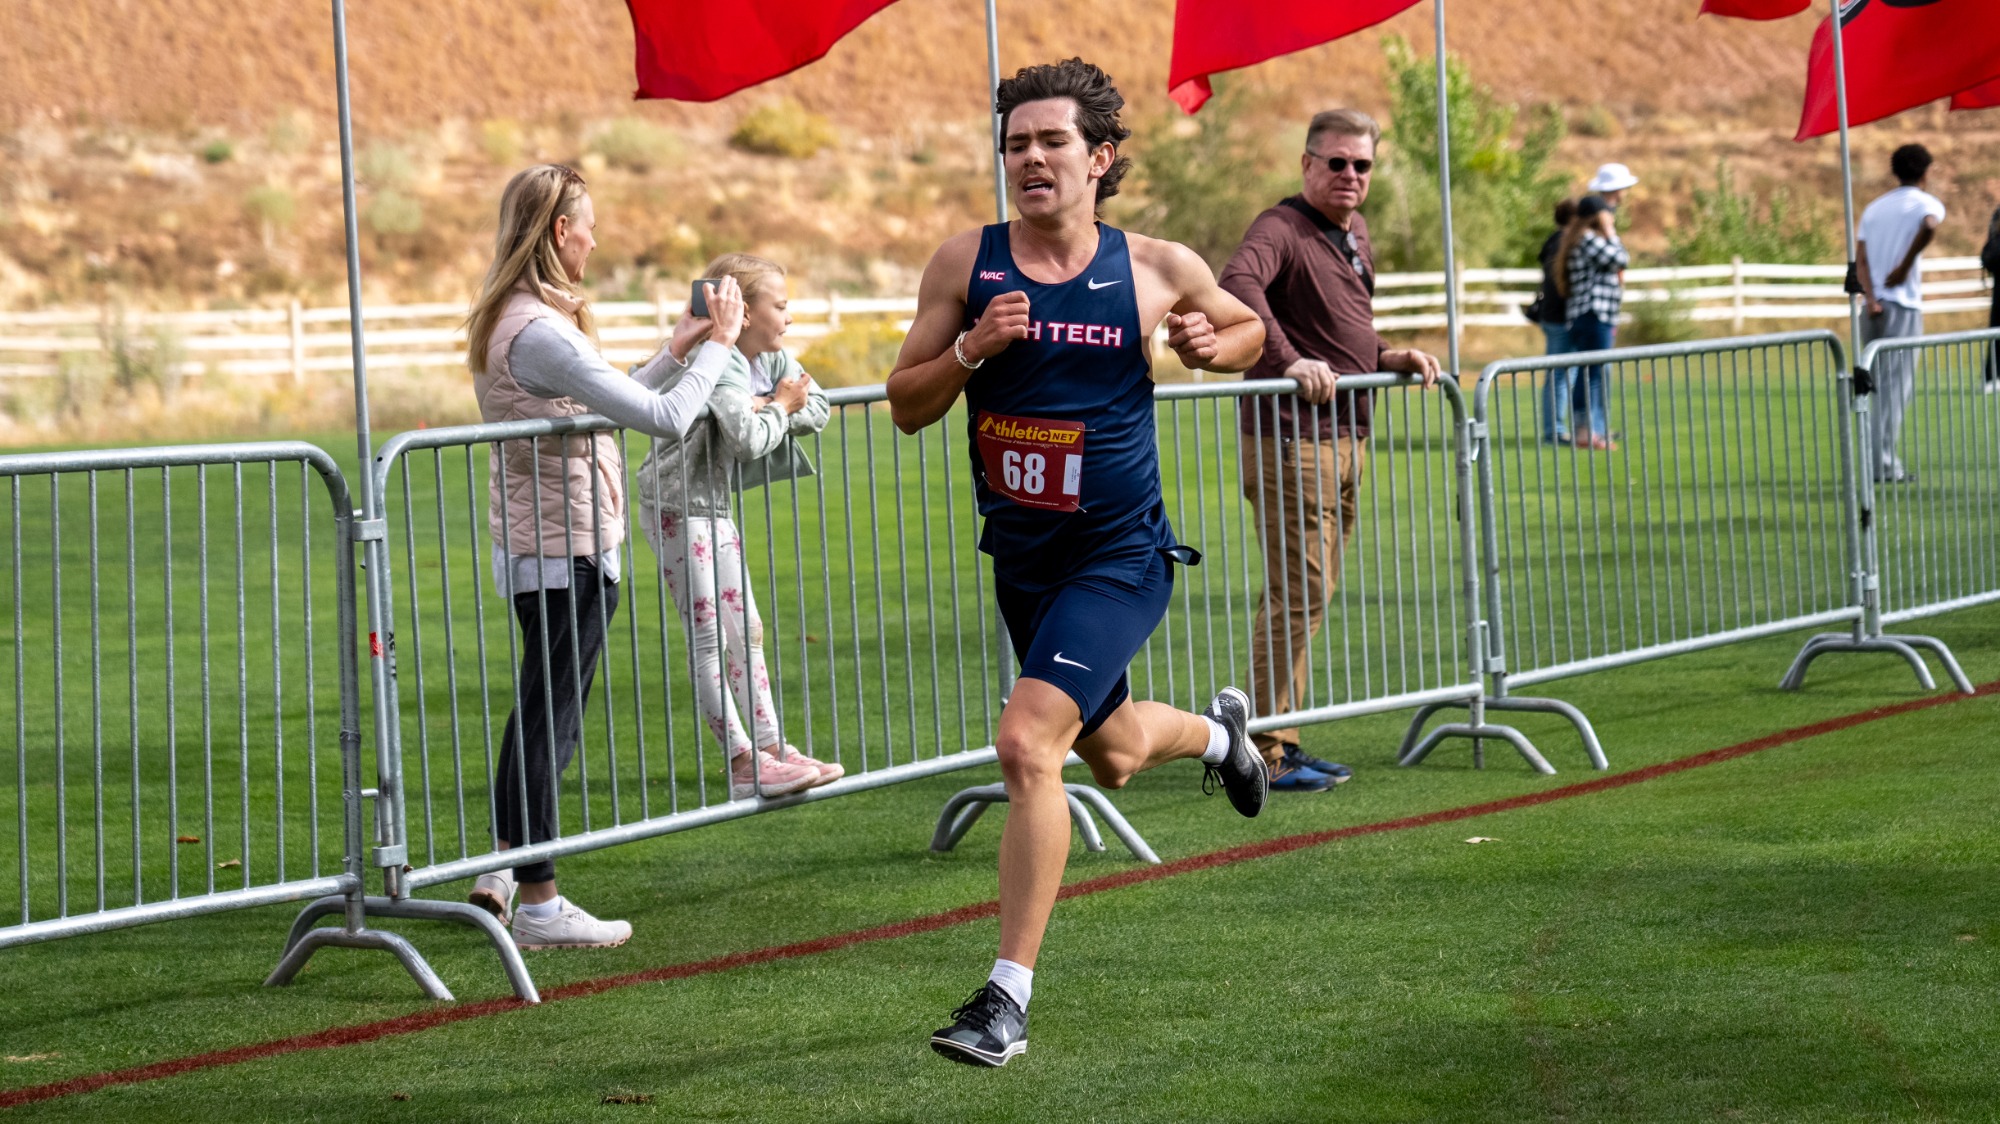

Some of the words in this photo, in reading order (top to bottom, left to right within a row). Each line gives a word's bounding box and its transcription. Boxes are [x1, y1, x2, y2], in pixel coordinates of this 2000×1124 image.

[979, 270, 1005, 281] WAC
[1047, 322, 1123, 347] TECH
[1002, 450, 1046, 495] 68
